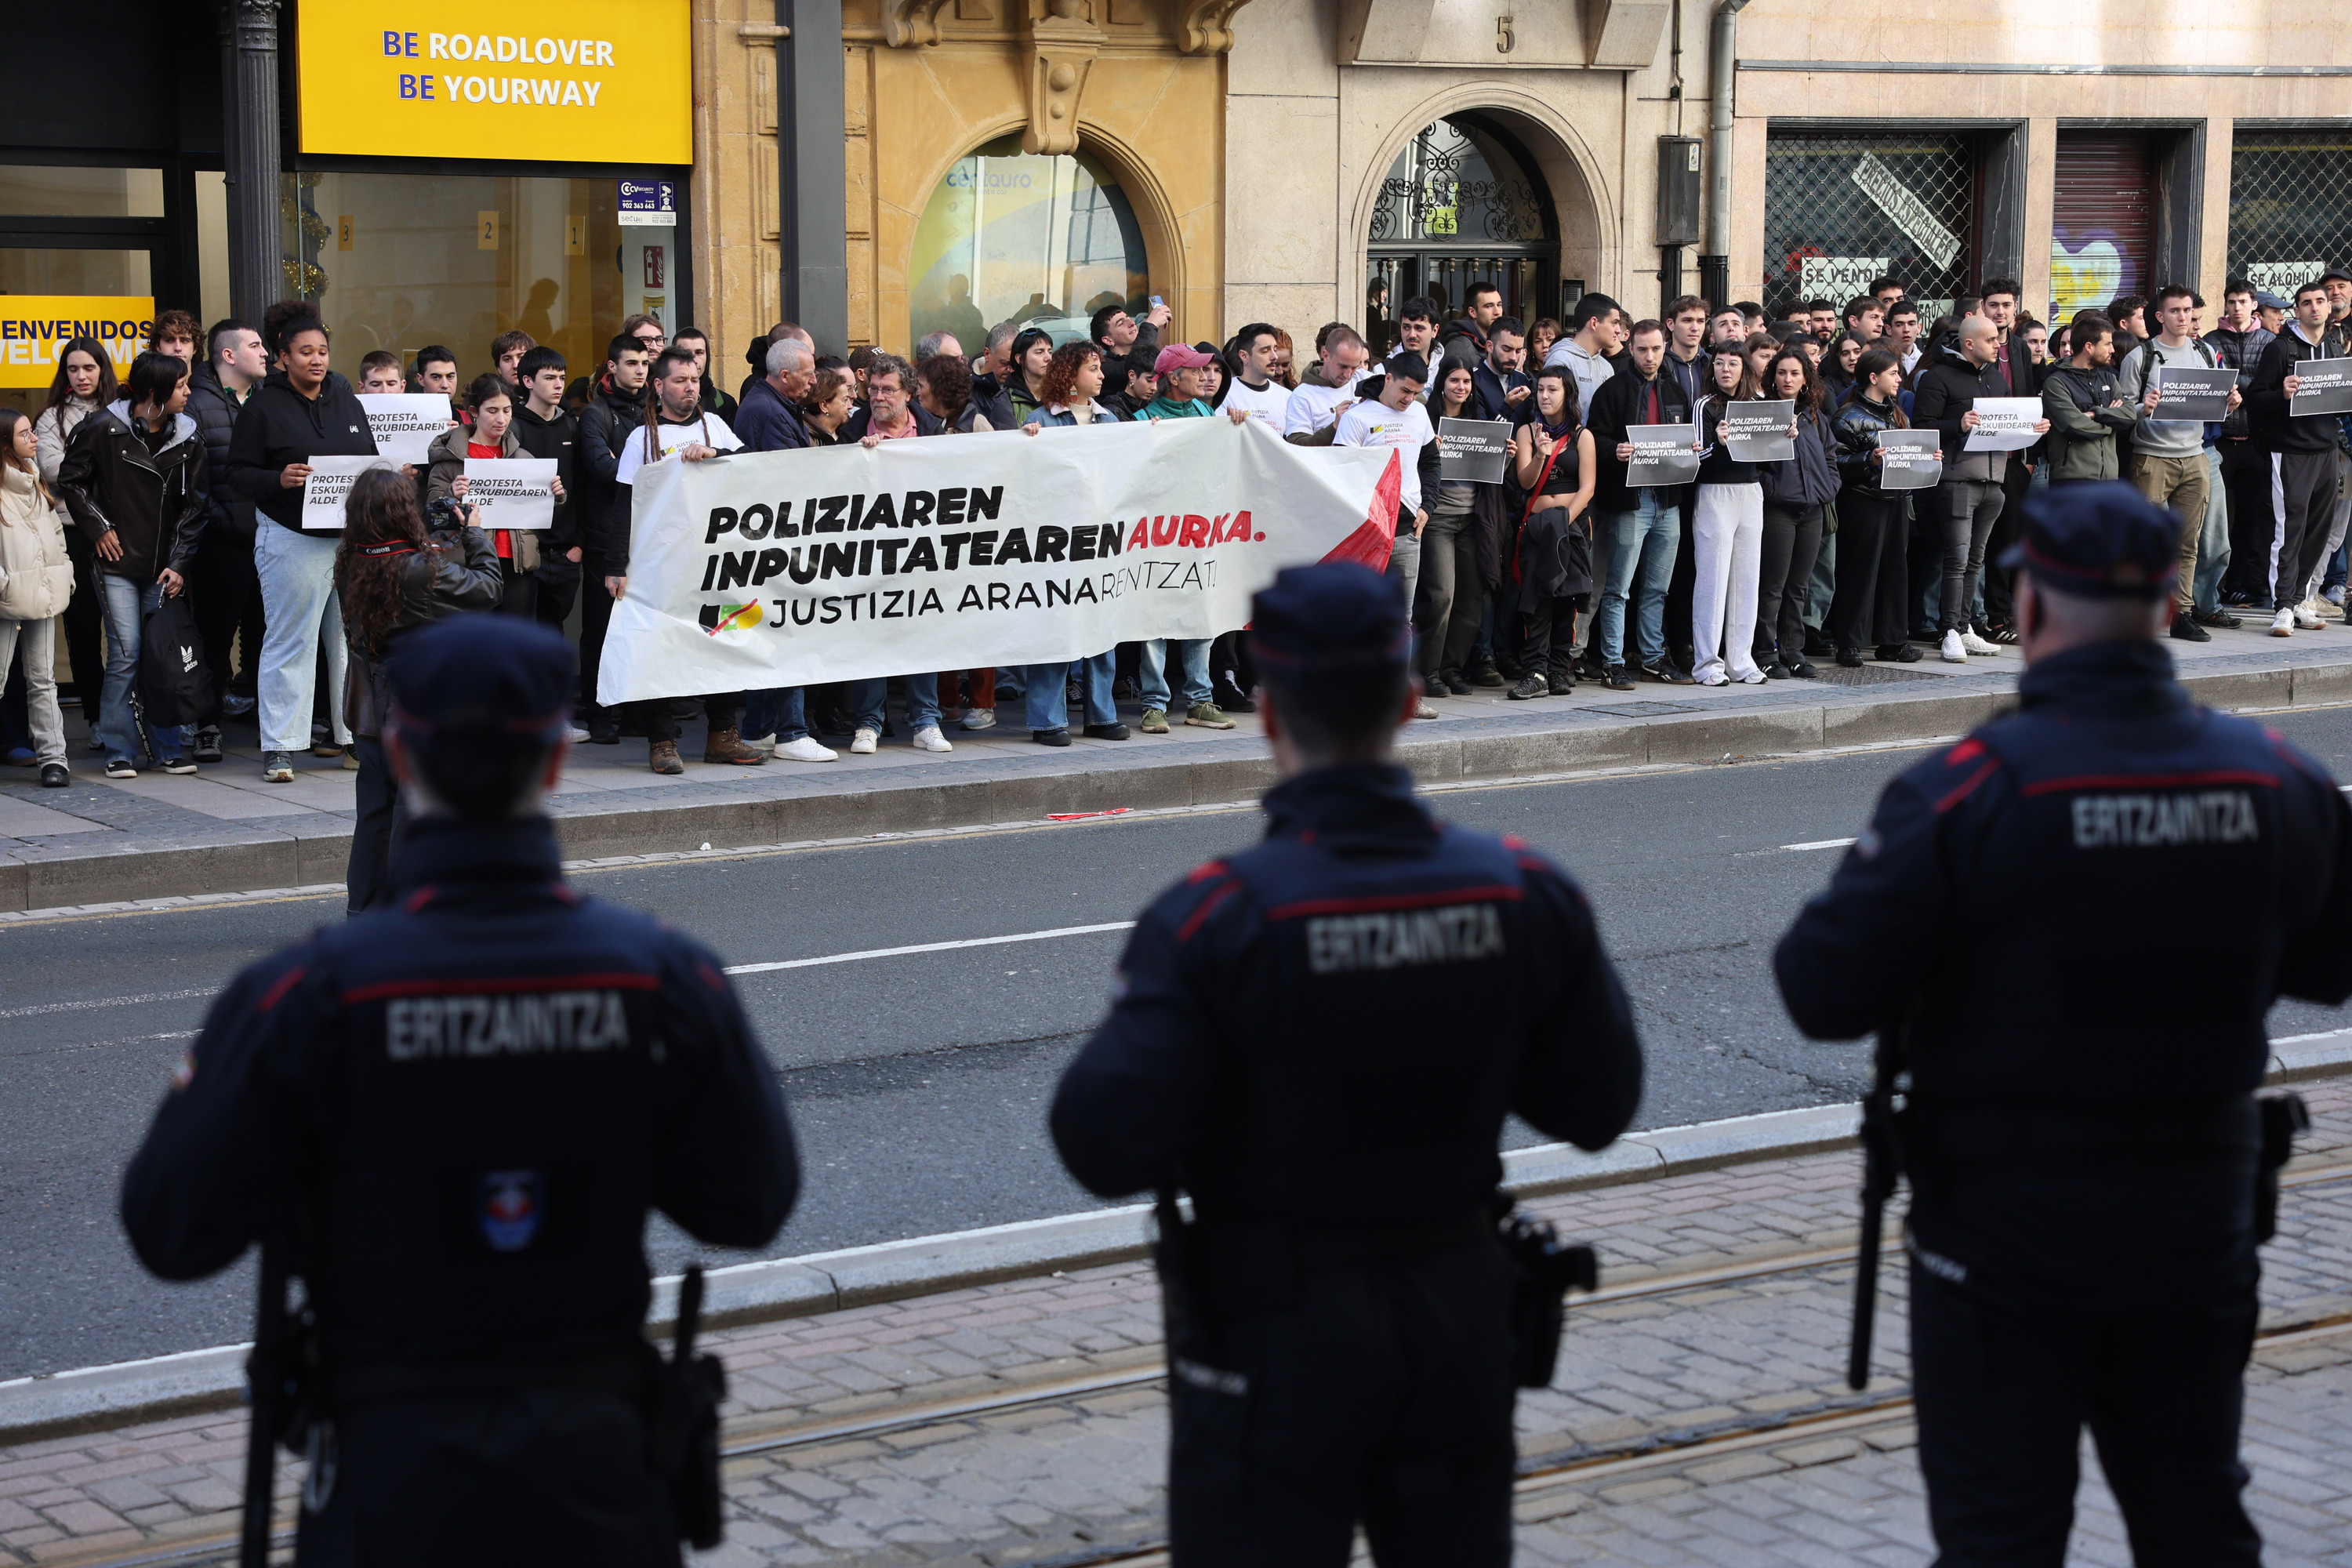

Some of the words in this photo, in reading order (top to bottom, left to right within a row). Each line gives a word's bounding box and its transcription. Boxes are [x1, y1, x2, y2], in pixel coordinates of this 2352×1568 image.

[1497, 16, 1515, 53] 5
[383, 31, 419, 57] BE
[429, 32, 615, 67] ROADLOVER
[398, 74, 434, 100] BE
[443, 75, 601, 107] YOURWAY
[343, 225, 349, 241] 3
[485, 222, 492, 240] 2
[572, 227, 579, 245] 1
[1806, 268, 1824, 283] SE
[2250, 273, 2265, 287] SE
[2299, 374, 2343, 383] POLIZIAREN
[369, 423, 445, 432] SKUBIDEAREN
[1728, 424, 1791, 433] INPUNITATEAREN
[373, 434, 391, 442] LDE
[1443, 435, 1486, 445] POLIZIAREN
[1727, 433, 1751, 441] AURKA
[1439, 443, 1504, 453] INPUNITATEAREN
[468, 488, 548, 497] ESKUBIDEAREN
[704, 485, 1004, 544] POLIZIAREN
[700, 521, 1126, 591] INPUNITATEAREN
[1127, 510, 1267, 553] AURKA.
[769, 586, 945, 628] JUSTIZIA
[956, 560, 1218, 613] ARANARENTZAT!
[183, 660, 198, 673] adidas
[2071, 791, 2258, 848] ERTZAINTZA
[1307, 903, 1505, 975] ERTZAINTZA
[387, 989, 629, 1060] ERTZAINTZA
